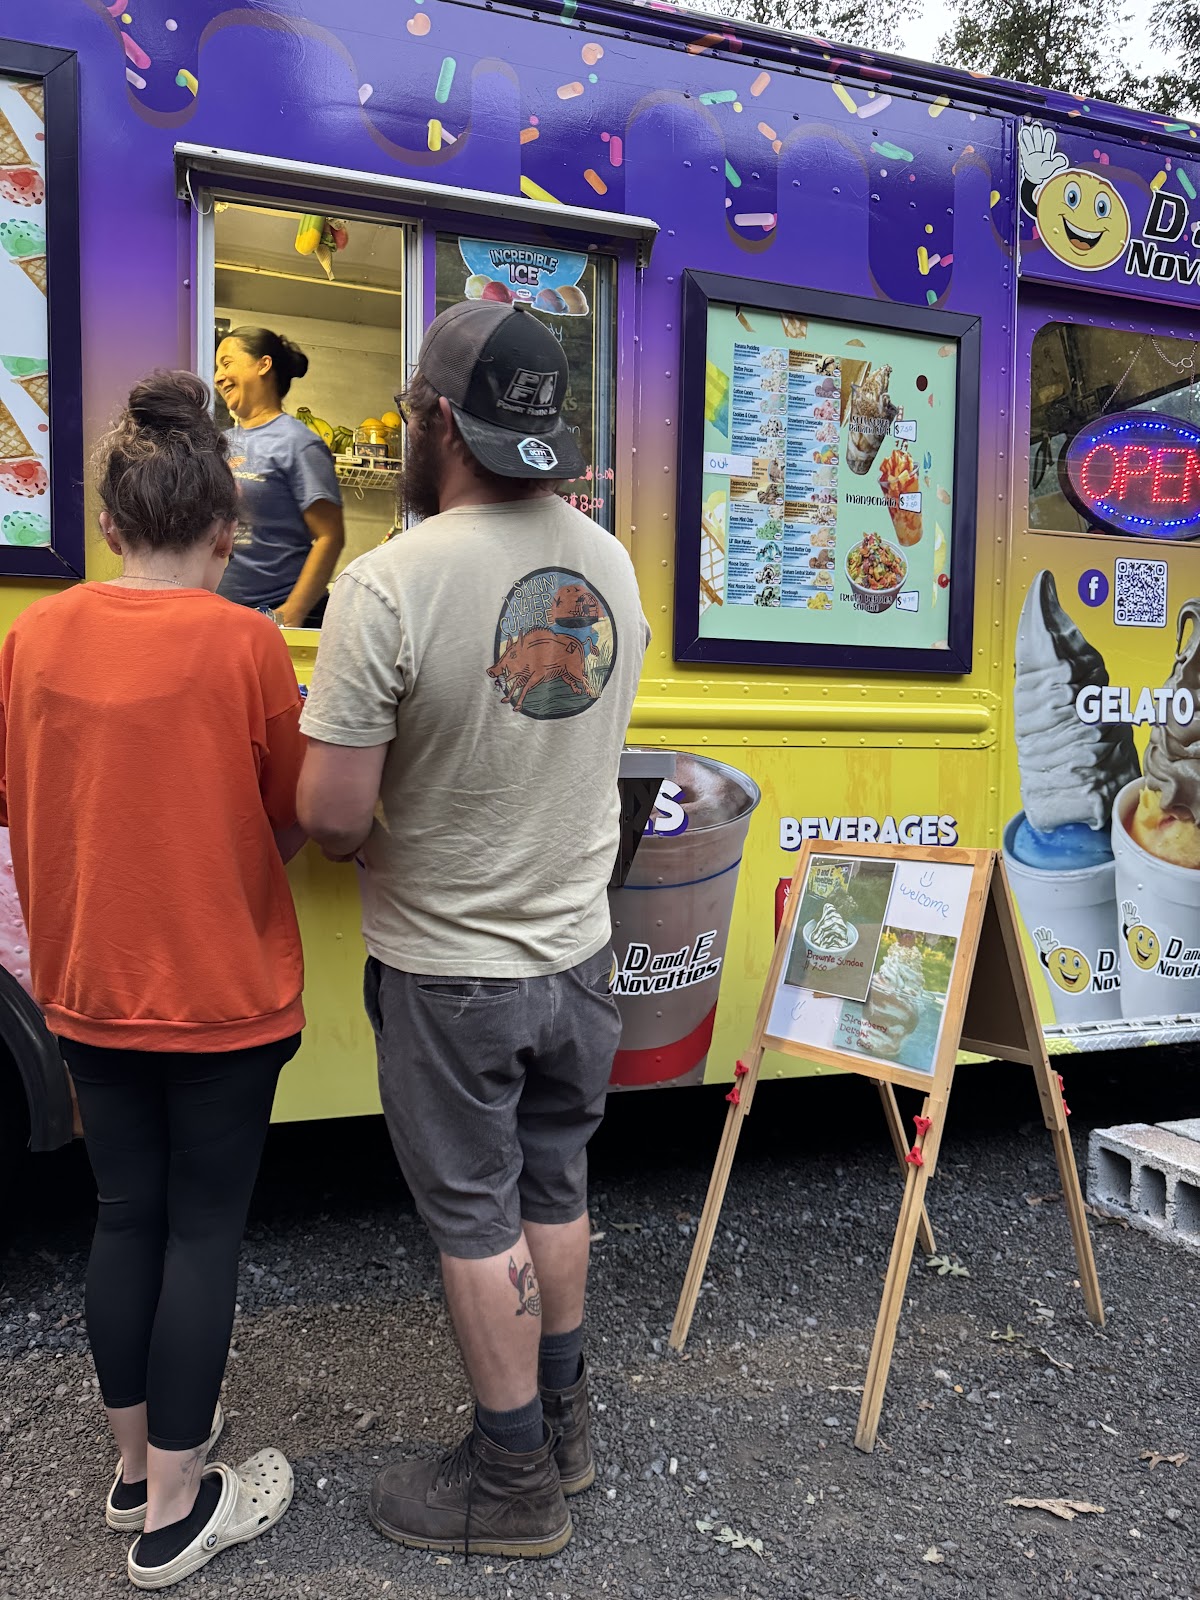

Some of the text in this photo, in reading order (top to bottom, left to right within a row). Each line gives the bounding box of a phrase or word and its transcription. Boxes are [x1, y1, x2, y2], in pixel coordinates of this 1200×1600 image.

[1143, 190, 1188, 242] D
[489, 249, 558, 270] INCREDIBLE
[1126, 240, 1200, 284] Nov
[510, 264, 539, 285] ICE
[788, 372, 805, 380] Raspberry
[787, 417, 805, 425] Strawberry
[502, 593, 552, 617] WATER
[1076, 685, 1194, 726] GELATO
[779, 814, 958, 852] BEVERAGES
[622, 930, 717, 972] D and E
[1165, 937, 1183, 960] D
[1097, 950, 1115, 973] D
[613, 958, 721, 994] Novelties
